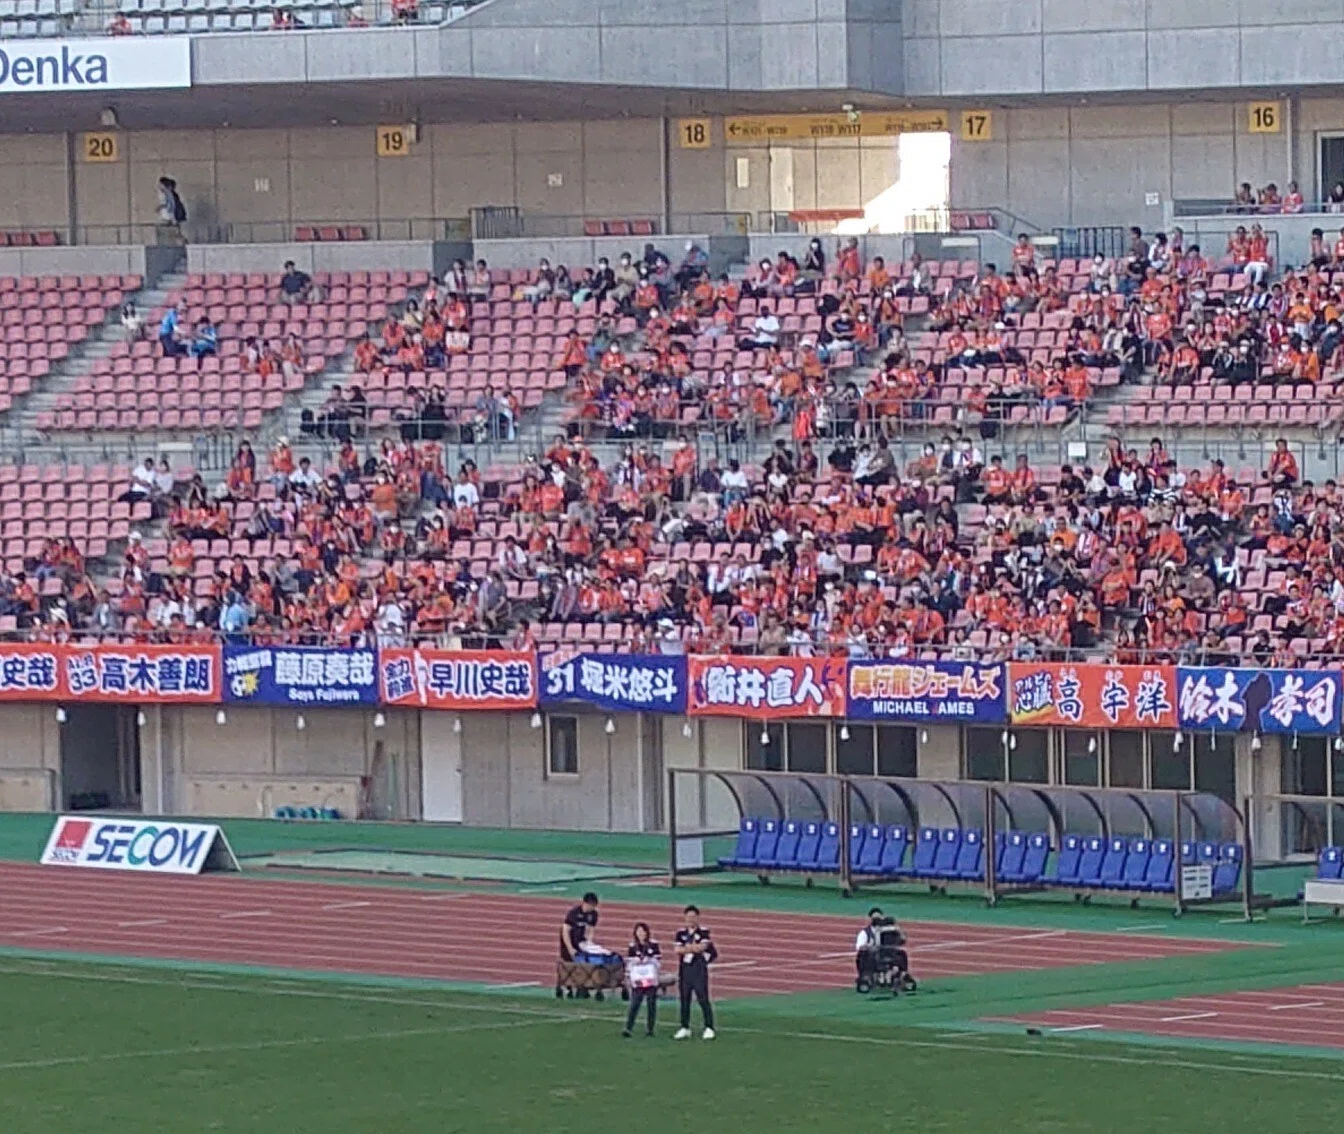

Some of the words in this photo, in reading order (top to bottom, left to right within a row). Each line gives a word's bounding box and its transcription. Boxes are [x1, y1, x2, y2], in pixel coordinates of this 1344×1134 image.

[966, 116, 986, 135] 17
[1253, 107, 1274, 128] 16
[382, 132, 404, 152] 19
[685, 124, 706, 144] 18
[88, 137, 114, 158] 20
[71, 668, 97, 691] 33
[101, 656, 212, 691] 高木善朗
[429, 662, 530, 696] 早川史哉
[546, 662, 575, 694] 31
[707, 664, 824, 708] 新井直人
[872, 700, 930, 714] MICHAEL
[86, 824, 208, 869] SECOM
